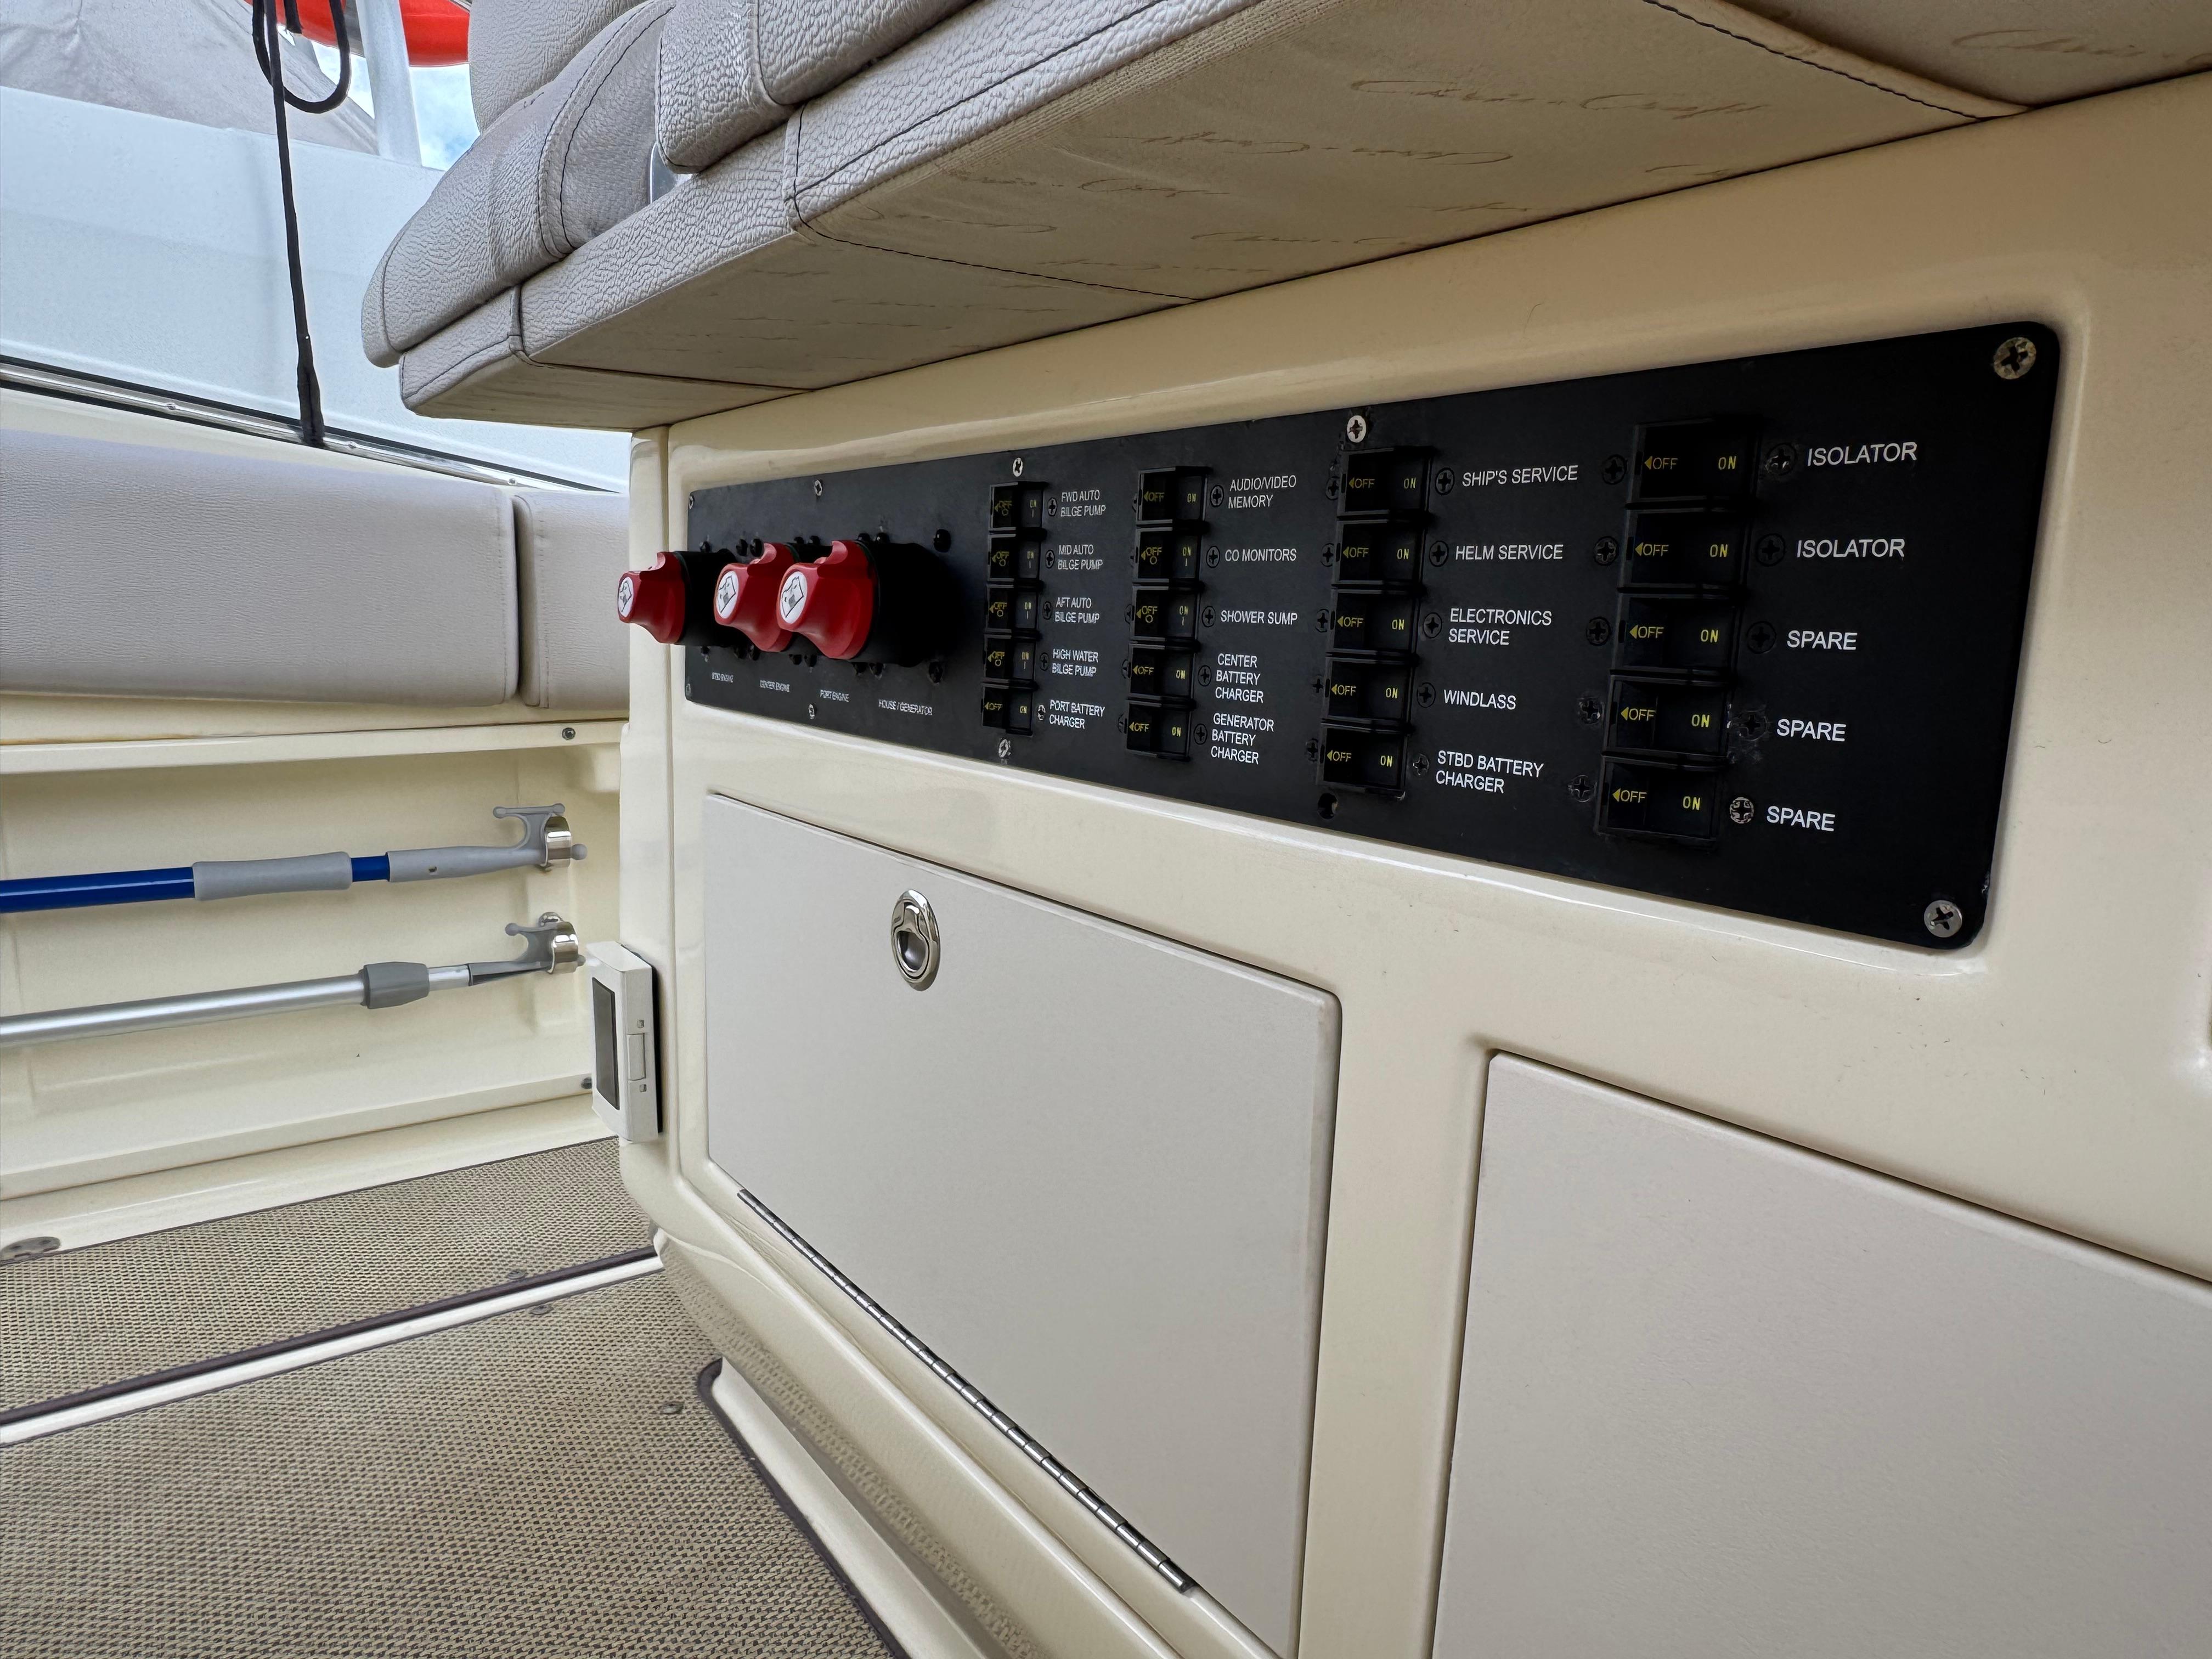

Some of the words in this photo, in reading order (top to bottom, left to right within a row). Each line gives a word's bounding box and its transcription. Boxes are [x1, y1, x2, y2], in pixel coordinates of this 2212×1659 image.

[1807, 442, 1918, 466] ISOLATOR
[1653, 457, 1678, 470] OFF
[1718, 456, 1736, 470] ON
[1462, 471, 1508, 487] SHIP'S
[1511, 465, 1578, 484] SERVICE
[1229, 476, 1296, 492] AUDIO/VIDEO
[1355, 478, 1374, 489] OFF
[1403, 478, 1416, 488] ON
[1061, 491, 1078, 501] FWD
[1079, 489, 1100, 501] AUTO
[1148, 492, 1164, 501] OFF
[1187, 494, 1196, 503] ON
[1228, 495, 1273, 509] MEMORY
[1060, 506, 1082, 517] BILGE
[1083, 504, 1106, 516] PUMP
[1058, 545, 1072, 555] MID
[1073, 544, 1094, 555] AUTO
[1146, 547, 1162, 556] OFF
[1182, 546, 1191, 556] ON
[1349, 548, 1368, 558] OFF
[1397, 549, 1409, 560] ON
[1455, 546, 1493, 560] HELM
[1498, 544, 1564, 560] SERVICE
[1643, 544, 1668, 556] OFF
[1710, 544, 1728, 557] ON
[1797, 538, 1905, 558] ISOLATOR
[1224, 549, 1239, 561] CO
[1242, 548, 1297, 562] MONITORS
[1057, 559, 1079, 570] BILGE
[1080, 559, 1103, 570] PUMP
[1056, 597, 1070, 608] AFT
[1071, 597, 1092, 608] AUTO
[1141, 606, 1158, 614] OFF
[1180, 606, 1188, 615] ON
[1054, 612, 1076, 623] BILGE
[1077, 612, 1100, 624] PUMP
[1220, 610, 1265, 624] SHOWER
[1267, 612, 1297, 625] SUMP
[1344, 617, 1363, 628] OFF
[1449, 608, 1552, 626] ELECTRONICS
[1392, 619, 1404, 630] ON
[1448, 629, 1509, 646] SERVICE
[1638, 626, 1663, 639] OFF
[1701, 629, 1719, 642] ON
[1786, 630, 1858, 651] SPARE
[1053, 648, 1071, 660] HIGH
[1071, 651, 1098, 663] WATER
[1217, 653, 1257, 668] CENTER
[1052, 663, 1074, 675] BILGE
[1074, 665, 1097, 677] PUMP
[1138, 666, 1154, 675] OFF
[1176, 670, 1185, 679] ON
[1216, 670, 1260, 685] BATTERY
[1215, 687, 1263, 703] CHARGER
[1338, 685, 1356, 696] OFF
[1386, 687, 1398, 699] ON
[1443, 689, 1516, 710] WINDLASS
[1049, 701, 1070, 712] PORT
[1071, 702, 1105, 717] BATTERY
[1629, 708, 1655, 721] OFF
[1049, 714, 1085, 729] CHARGER
[1213, 713, 1274, 732] GENERATOR
[1691, 714, 1710, 727] ON
[1134, 723, 1149, 732] OFF
[1172, 727, 1181, 737] ON
[1776, 719, 1847, 742] SPARE
[1212, 730, 1256, 746] BATTERY
[1211, 746, 1259, 764] CHARGER
[1332, 751, 1351, 762] OFF
[1380, 755, 1392, 766] ON
[1437, 749, 1475, 769] STBD
[1477, 756, 1544, 778] BATTERY
[1435, 770, 1504, 793] CHARGER
[1621, 791, 1646, 803] OFF
[1683, 797, 1701, 810] ON
[1767, 806, 1836, 832] SPARE
